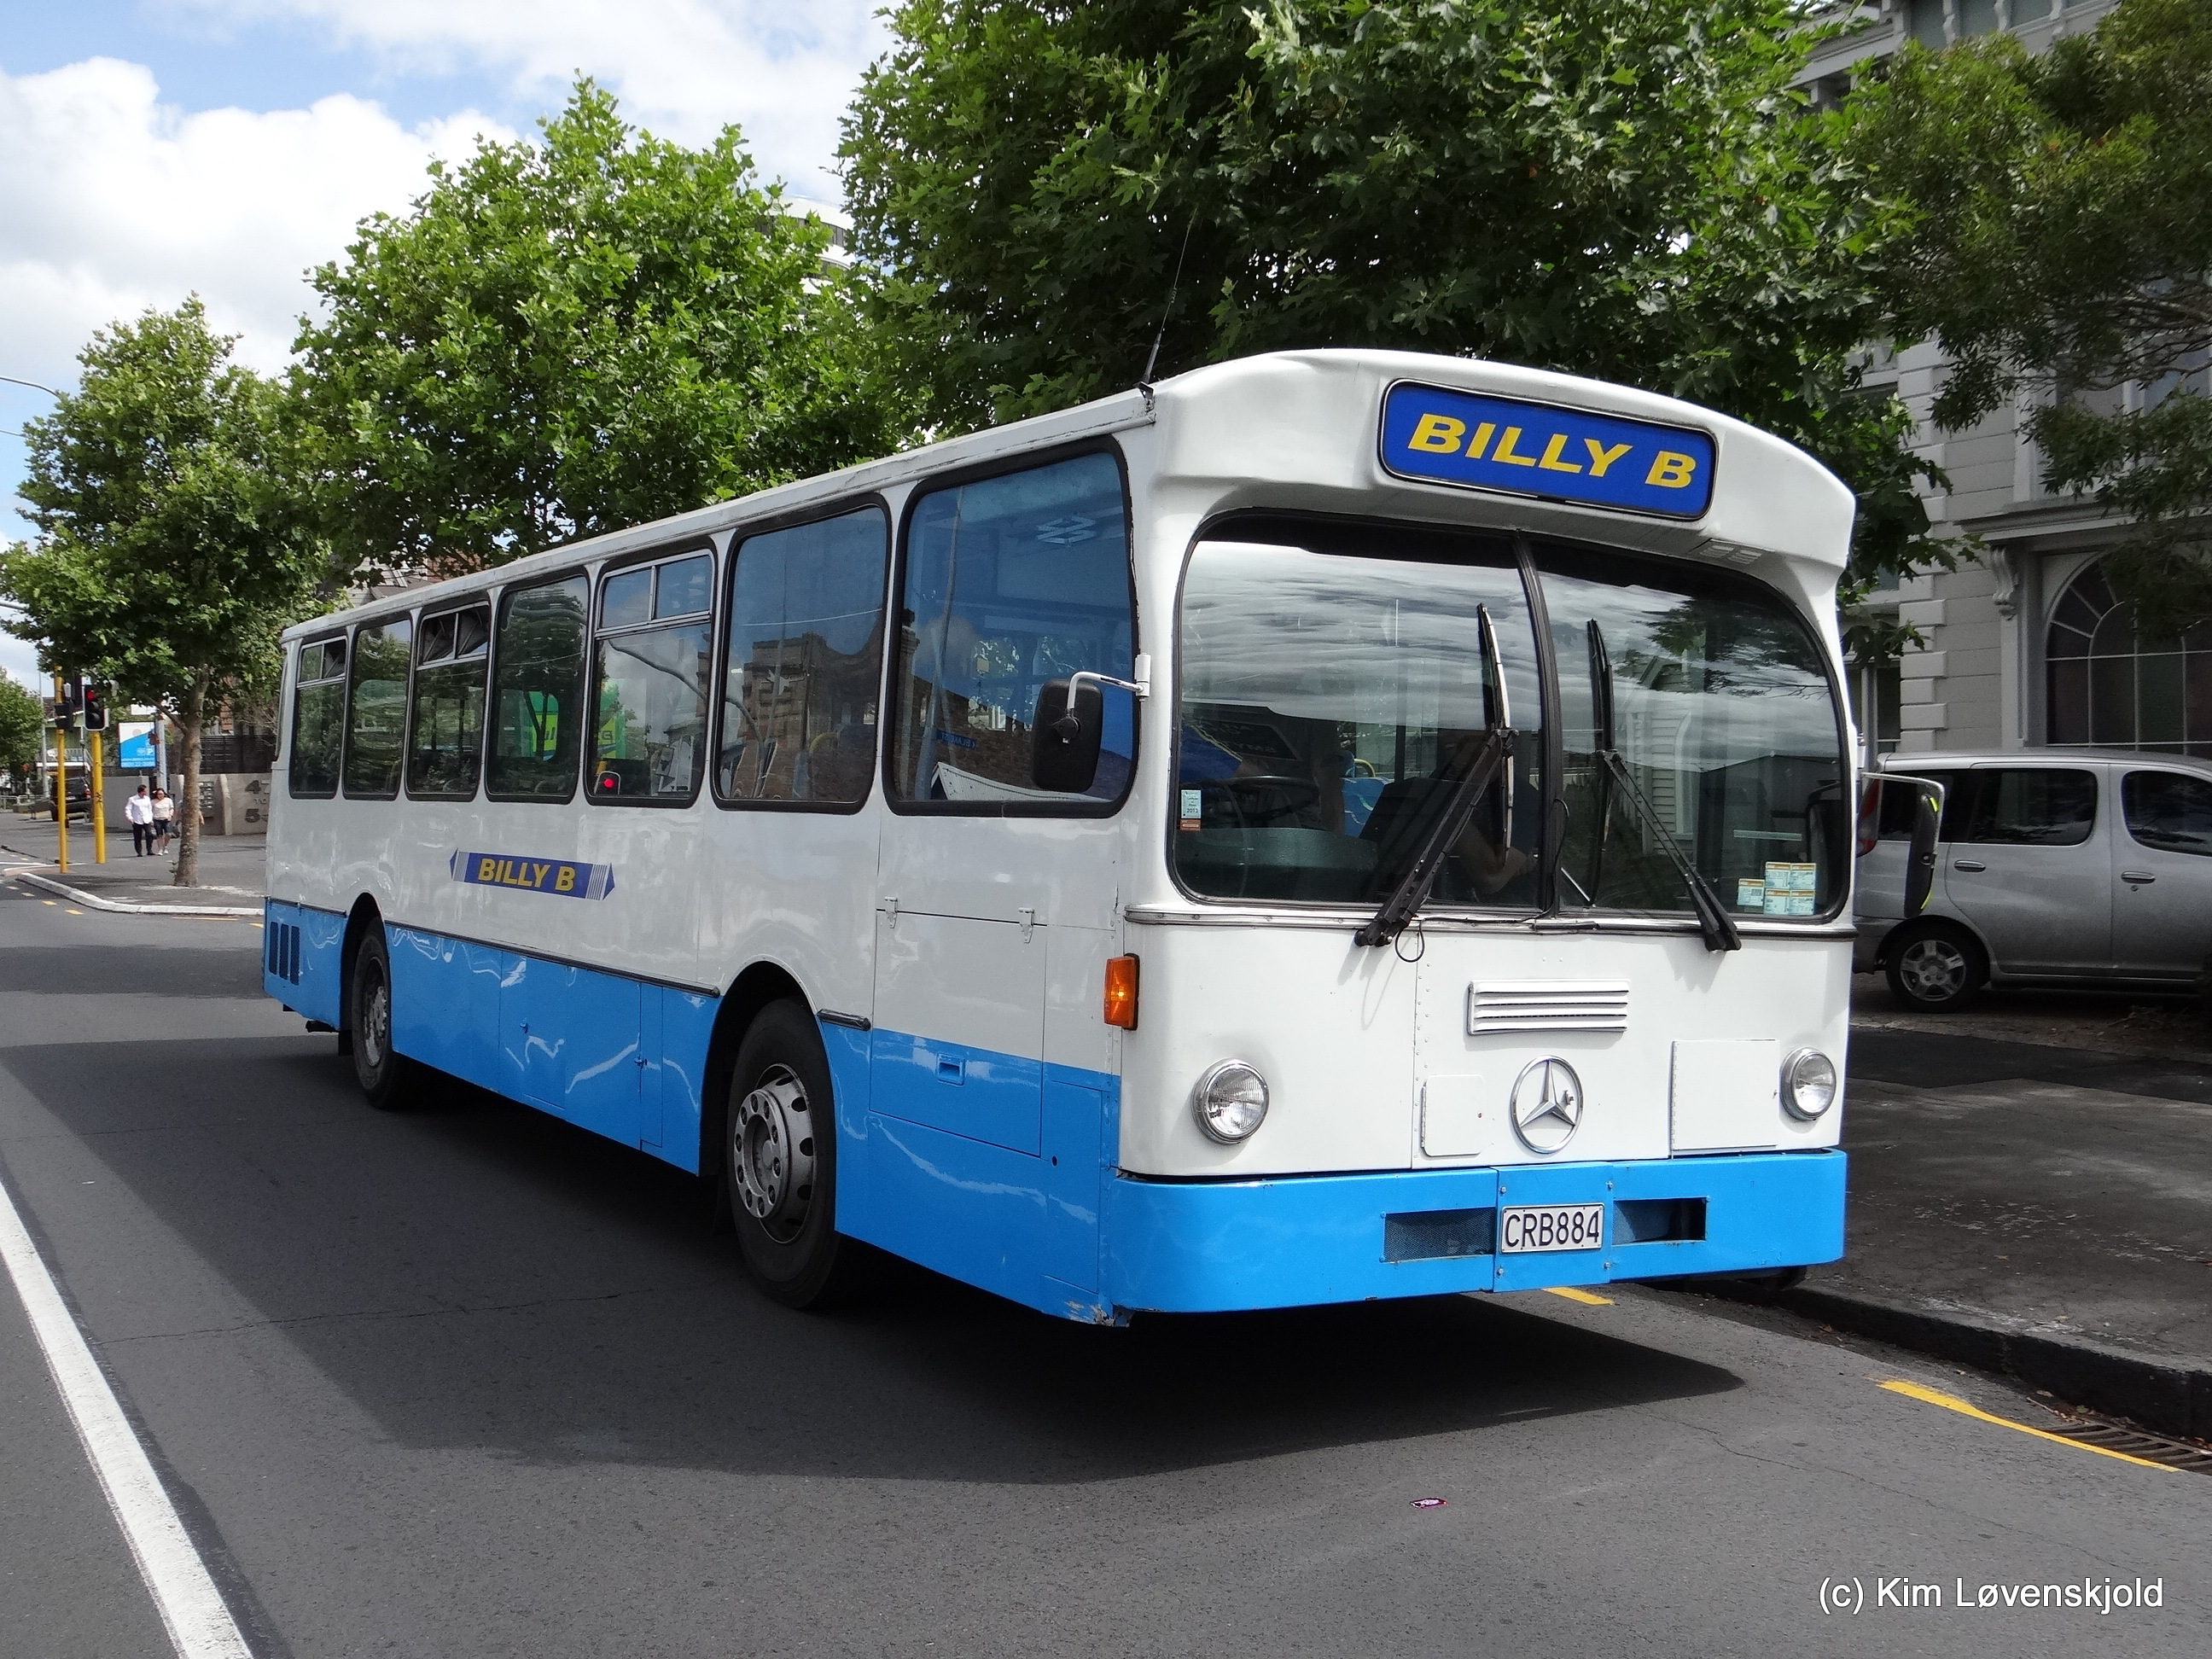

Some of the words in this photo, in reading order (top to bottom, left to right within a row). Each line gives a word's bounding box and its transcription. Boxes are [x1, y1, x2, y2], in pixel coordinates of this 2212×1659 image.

[1407, 413, 1633, 477] BILLY
[1644, 451, 1697, 489] B
[478, 858, 550, 888] BILLY
[555, 866, 576, 892] B
[1505, 1210, 1599, 1248] CRB884
